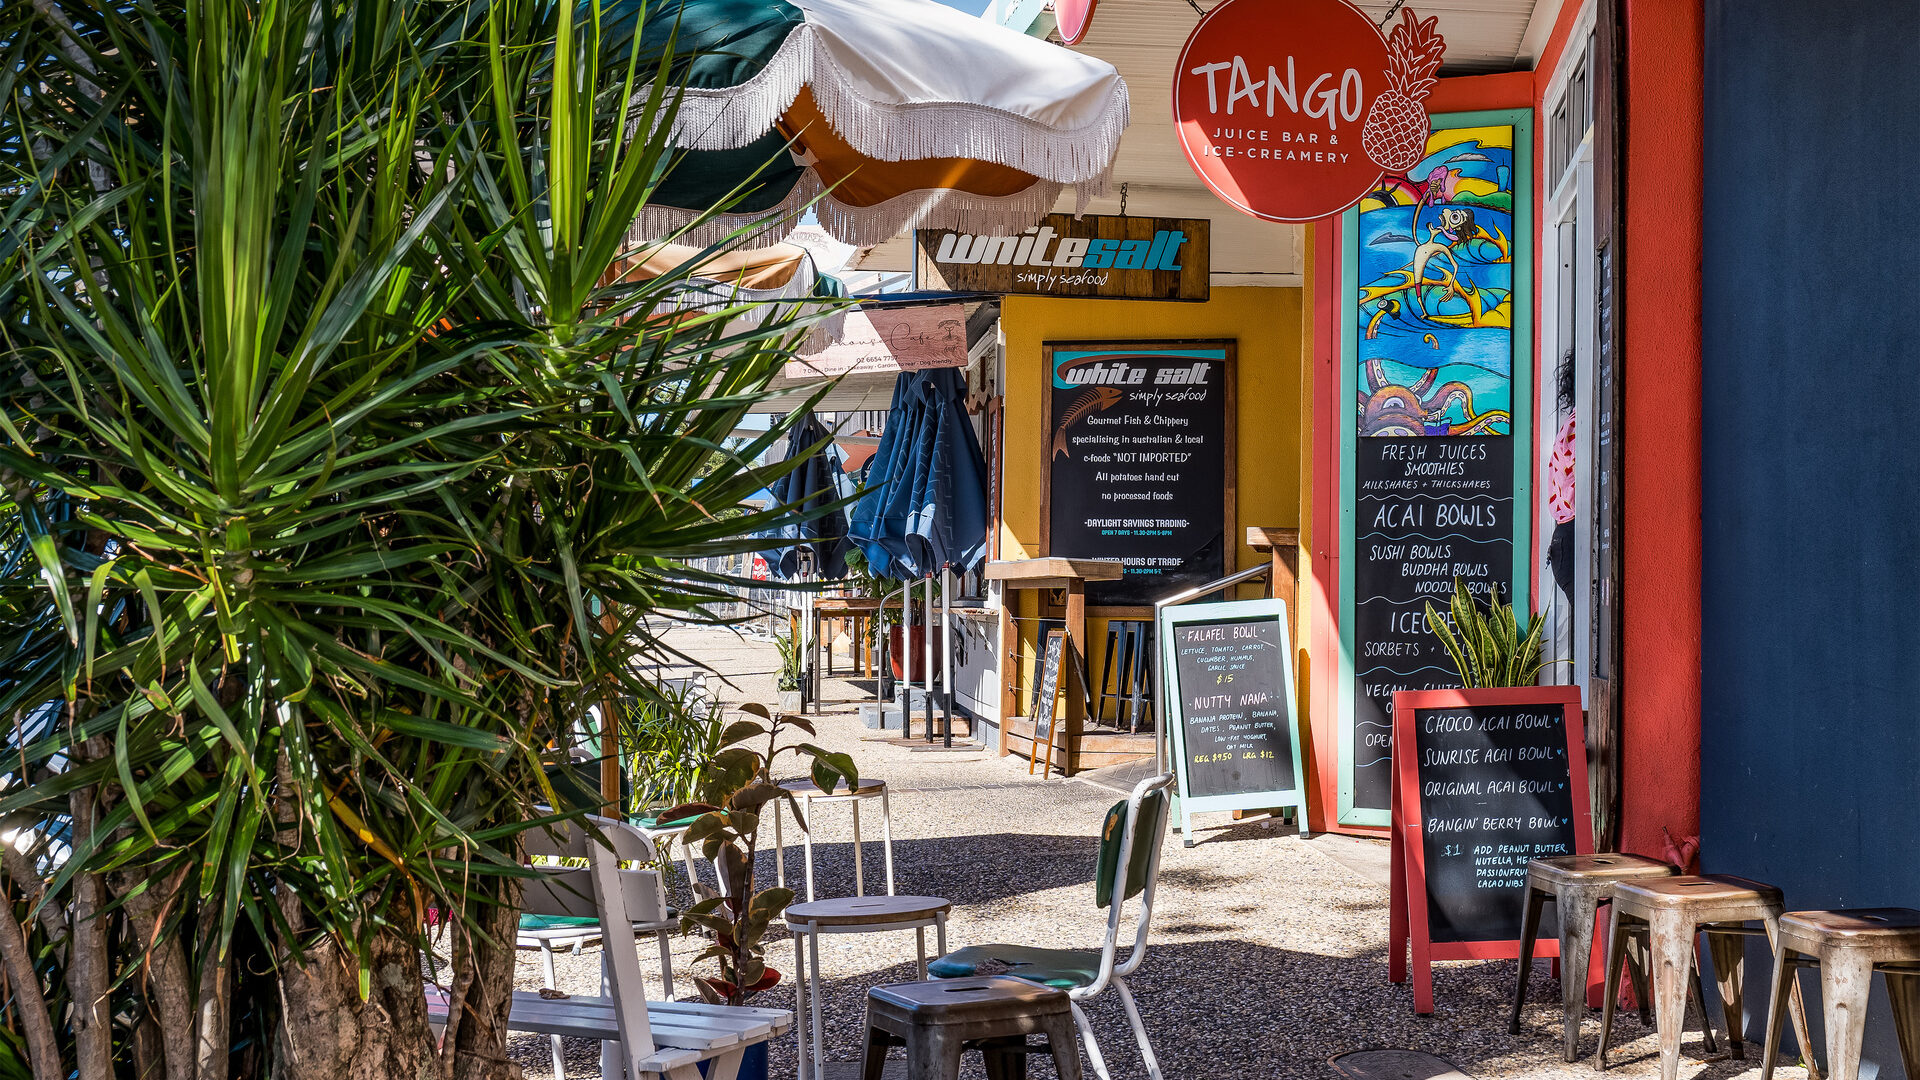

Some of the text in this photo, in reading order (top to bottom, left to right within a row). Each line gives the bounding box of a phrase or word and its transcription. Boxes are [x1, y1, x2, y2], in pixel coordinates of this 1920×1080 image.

[1192, 55, 1363, 130] TANGO
[1213, 127, 1339, 145] JUICE BAR &
[1204, 144, 1350, 164] ICE-CREAMERY
[1016, 269, 1109, 290] simply seafood
[1065, 362, 1211, 385] white salt
[1129, 386, 1208, 407] simply seafood
[1086, 414, 1188, 427] Gourmet Fish & Chippery
[1072, 434, 1204, 445] specialising in australian & local
[1382, 444, 1486, 461] FRESH JUICES
[1404, 462, 1464, 476] SMOOTHIES
[1096, 472, 1180, 484] All potatoes hand cut
[1362, 480, 1418, 490] MILKSHAKES
[1431, 480, 1491, 488] THICKSHAKES
[1114, 491, 1150, 502] processed
[1152, 491, 1173, 501] foods
[1122, 518, 1154, 528] SAVINGS
[1374, 504, 1496, 528] ACAI BOWLS
[1370, 544, 1452, 561] SUSHI BOWLS
[1123, 558, 1146, 566] HOURS
[1147, 558, 1156, 566] OF
[1402, 562, 1488, 576] BUDDHA BOWLS
[1414, 581, 1507, 594] NOODL BOWS
[1187, 626, 1258, 642] FALAFEL BOWL
[1181, 647, 1208, 656] LETTUCE,
[1364, 642, 1420, 656] SORBETS
[1196, 656, 1228, 664] CUCUMBER,
[1194, 692, 1268, 710] NUTTY NANA
[1190, 710, 1279, 724] BANANA PROTEIN, BANANA,
[1425, 714, 1552, 734] CHOCO ACAI BOWL
[1254, 722, 1276, 730] BUTTER,
[1194, 755, 1210, 764] REG
[1260, 750, 1274, 759] $12
[1424, 746, 1554, 766] SUNRISE ACAI BOWL
[1424, 780, 1554, 796] ORIGINAL ACAI BOWL
[1428, 817, 1560, 833] BANGIN' BERRY BOWL
[1445, 844, 1568, 856] $1 ADD PEANUT BUTTER,
[1475, 856, 1514, 866] NUTELLA,
[1476, 868, 1528, 877] PASSIONFRUI
[1478, 879, 1524, 888] CACAO NIBS
